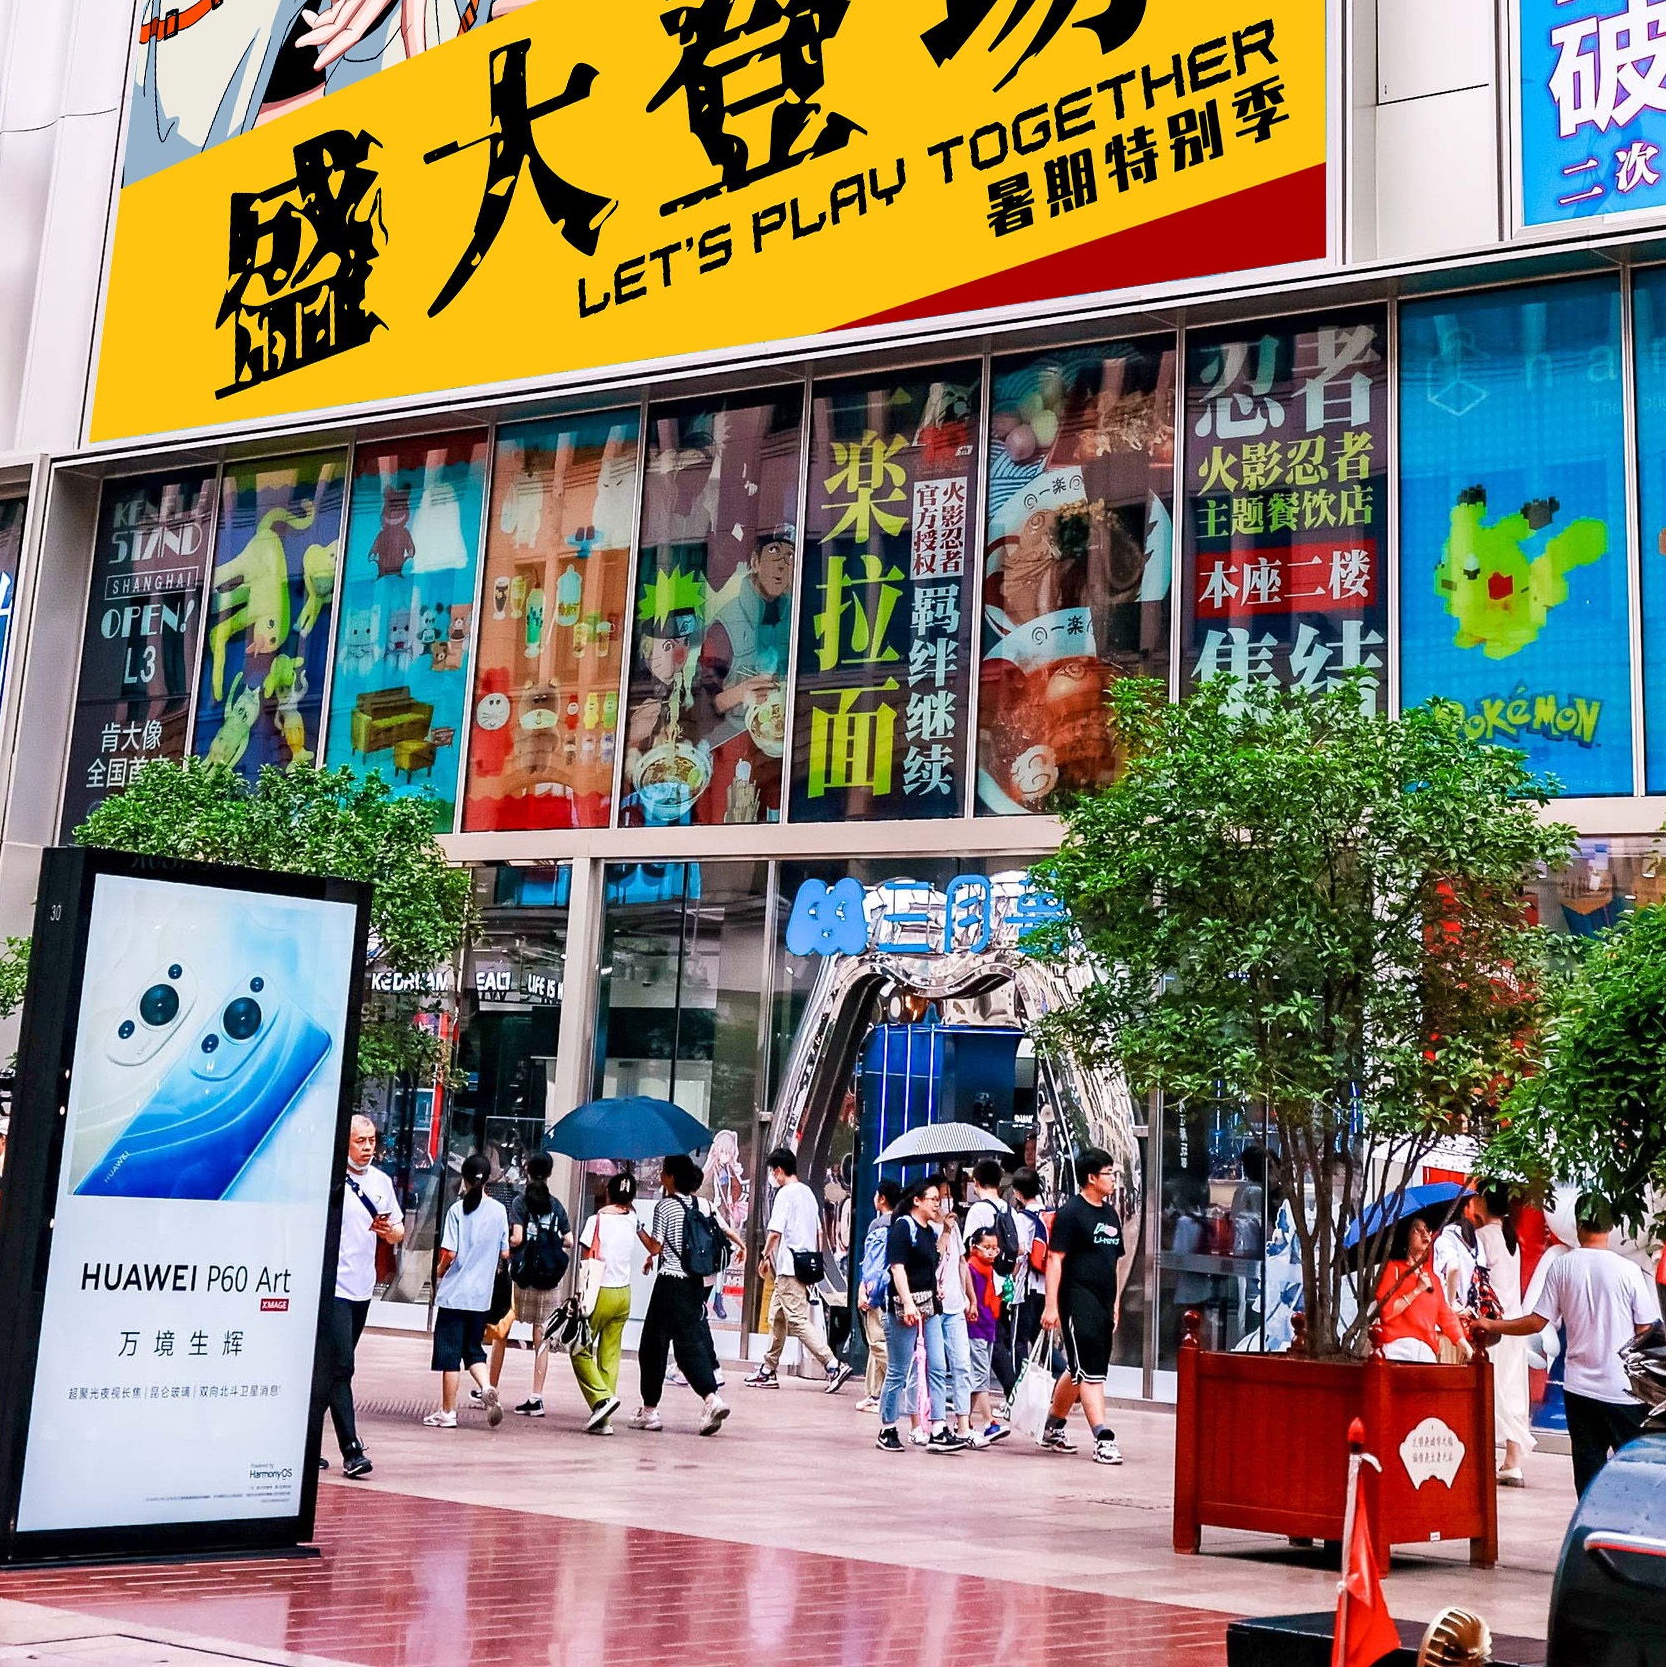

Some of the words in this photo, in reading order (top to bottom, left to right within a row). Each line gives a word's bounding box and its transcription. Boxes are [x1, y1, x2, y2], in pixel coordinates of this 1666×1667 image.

[576, 224, 733, 317] LET'S
[753, 156, 911, 253] PLAY
[929, 16, 1280, 180] TOGETHER
[987, 82, 1294, 239] 暑期特别季
[1195, 324, 1381, 440] 忍者
[1198, 430, 1375, 497] 火影忍者
[913, 484, 939, 577] 官方授权
[940, 481, 966, 574] 火影忍者
[1197, 484, 1375, 541] 主题餐饮店
[108, 523, 203, 565] STAND
[112, 572, 192, 595] SHANGHAI
[1198, 549, 1373, 612] 本座二楼
[100, 599, 195, 639] OPEN!
[124, 644, 157, 685] L3
[901, 584, 960, 799] 羁绊继续
[101, 719, 163, 753] 肯大像
[50, 904, 62, 923] 30
[81, 1263, 197, 1291] HUAWEI
[207, 1265, 248, 1292] P60
[255, 1266, 292, 1293] Art
[261, 1301, 288, 1310] XMAGE
[118, 1330, 244, 1357] 万境生辉
[69, 1387, 141, 1400] 超聚光夜视长焦
[149, 1386, 190, 1400] 昆仑玻璃
[249, 1468, 293, 1480] HarmonyOS
